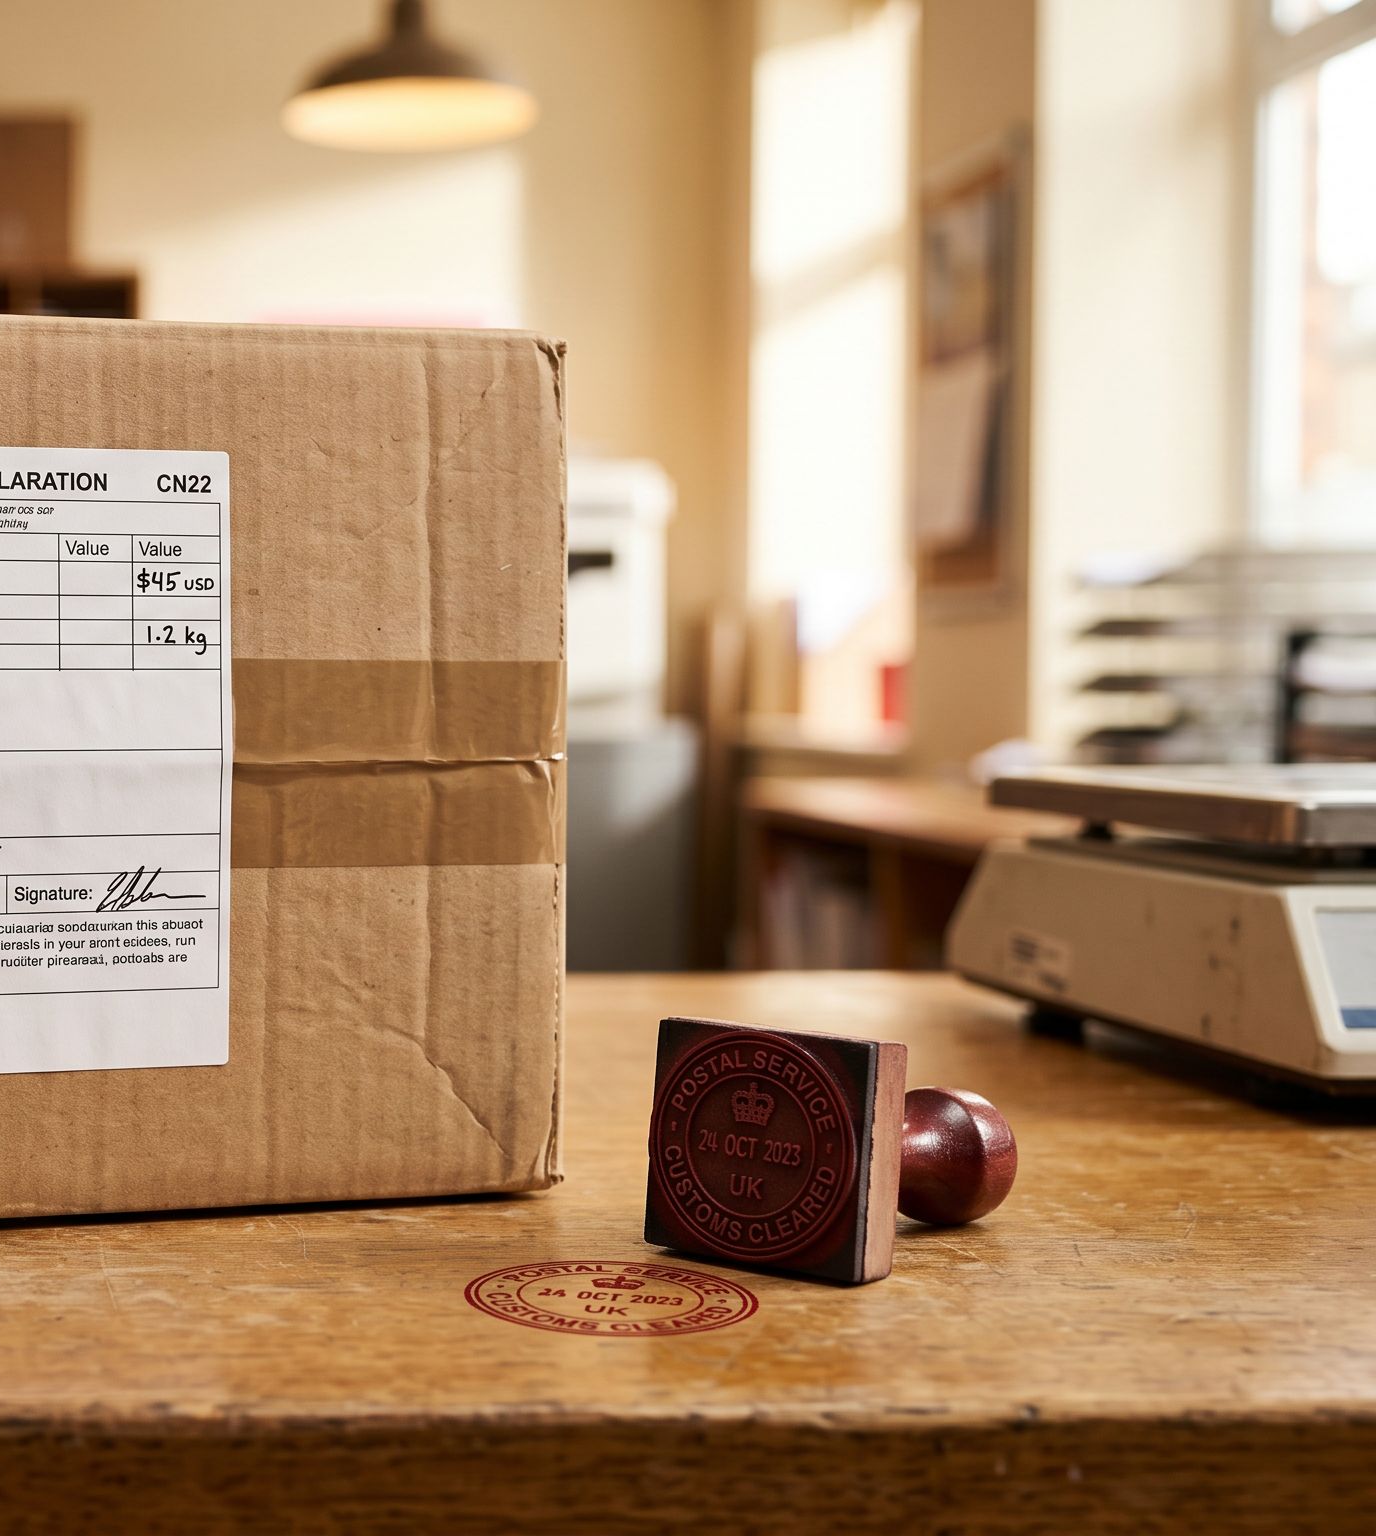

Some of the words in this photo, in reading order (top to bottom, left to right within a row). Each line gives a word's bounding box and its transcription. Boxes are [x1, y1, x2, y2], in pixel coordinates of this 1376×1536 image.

[157, 474, 211, 493] CN22
[66, 541, 109, 555] Value
[139, 542, 182, 556] Value
[137, 568, 181, 593] $45
[184, 578, 214, 591] USD
[146, 625, 176, 644] 1.2
[185, 626, 207, 655] kg
[14, 887, 92, 904] Signature:
[137, 920, 157, 930] this
[162, 919, 203, 929] abuaot
[44, 939, 54, 949] in
[176, 937, 195, 945] run
[168, 954, 187, 962] are
[671, 1049, 751, 1112] POSTAL
[753, 1050, 836, 1131] SERVICE
[699, 1129, 717, 1152] 24
[725, 1134, 759, 1157] OCT
[765, 1139, 802, 1167] 2023
[665, 1146, 741, 1242] CUSTOMS
[749, 1166, 836, 1244] CLEARED
[730, 1174, 763, 1200] UK
[504, 1265, 612, 1282] POSTAL
[624, 1267, 730, 1296] SERVICE
[578, 1291, 624, 1301] OCT
[631, 1295, 683, 1306] 2023
[486, 1292, 598, 1331] CUSTOMS
[610, 1307, 733, 1332] CLEARED
[584, 1305, 629, 1316] UK
